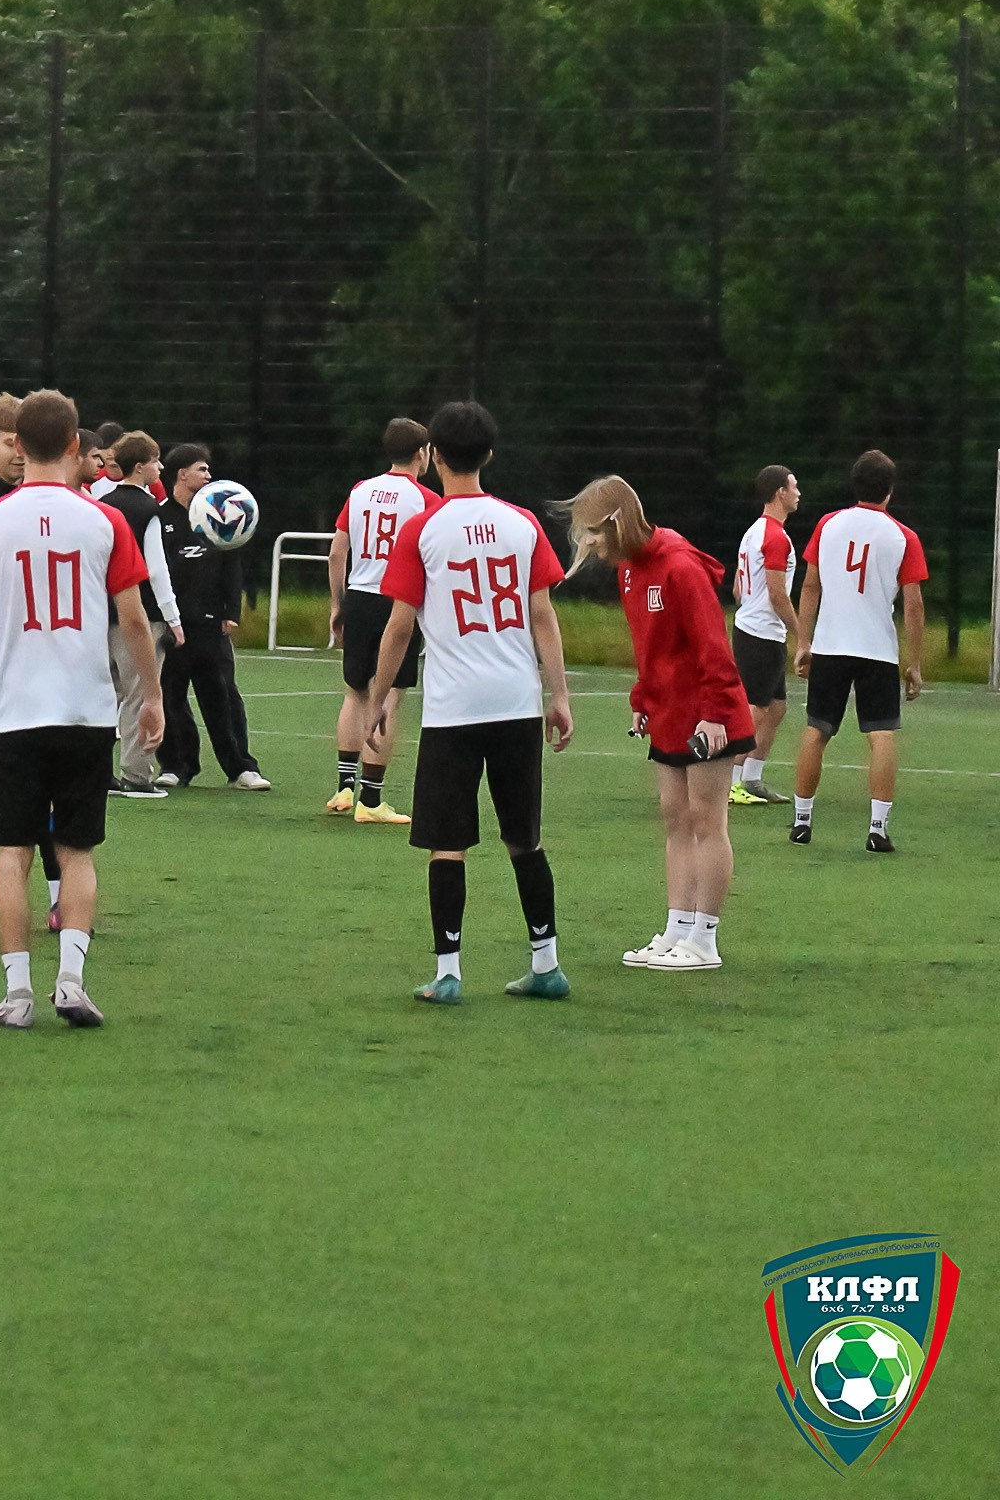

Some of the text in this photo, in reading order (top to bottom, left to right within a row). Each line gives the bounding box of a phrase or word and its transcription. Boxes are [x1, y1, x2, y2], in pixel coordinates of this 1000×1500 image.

[361, 510, 397, 561] 18
[846, 540, 870, 594] 4
[16, 549, 82, 631] 10
[447, 553, 525, 638] 28
